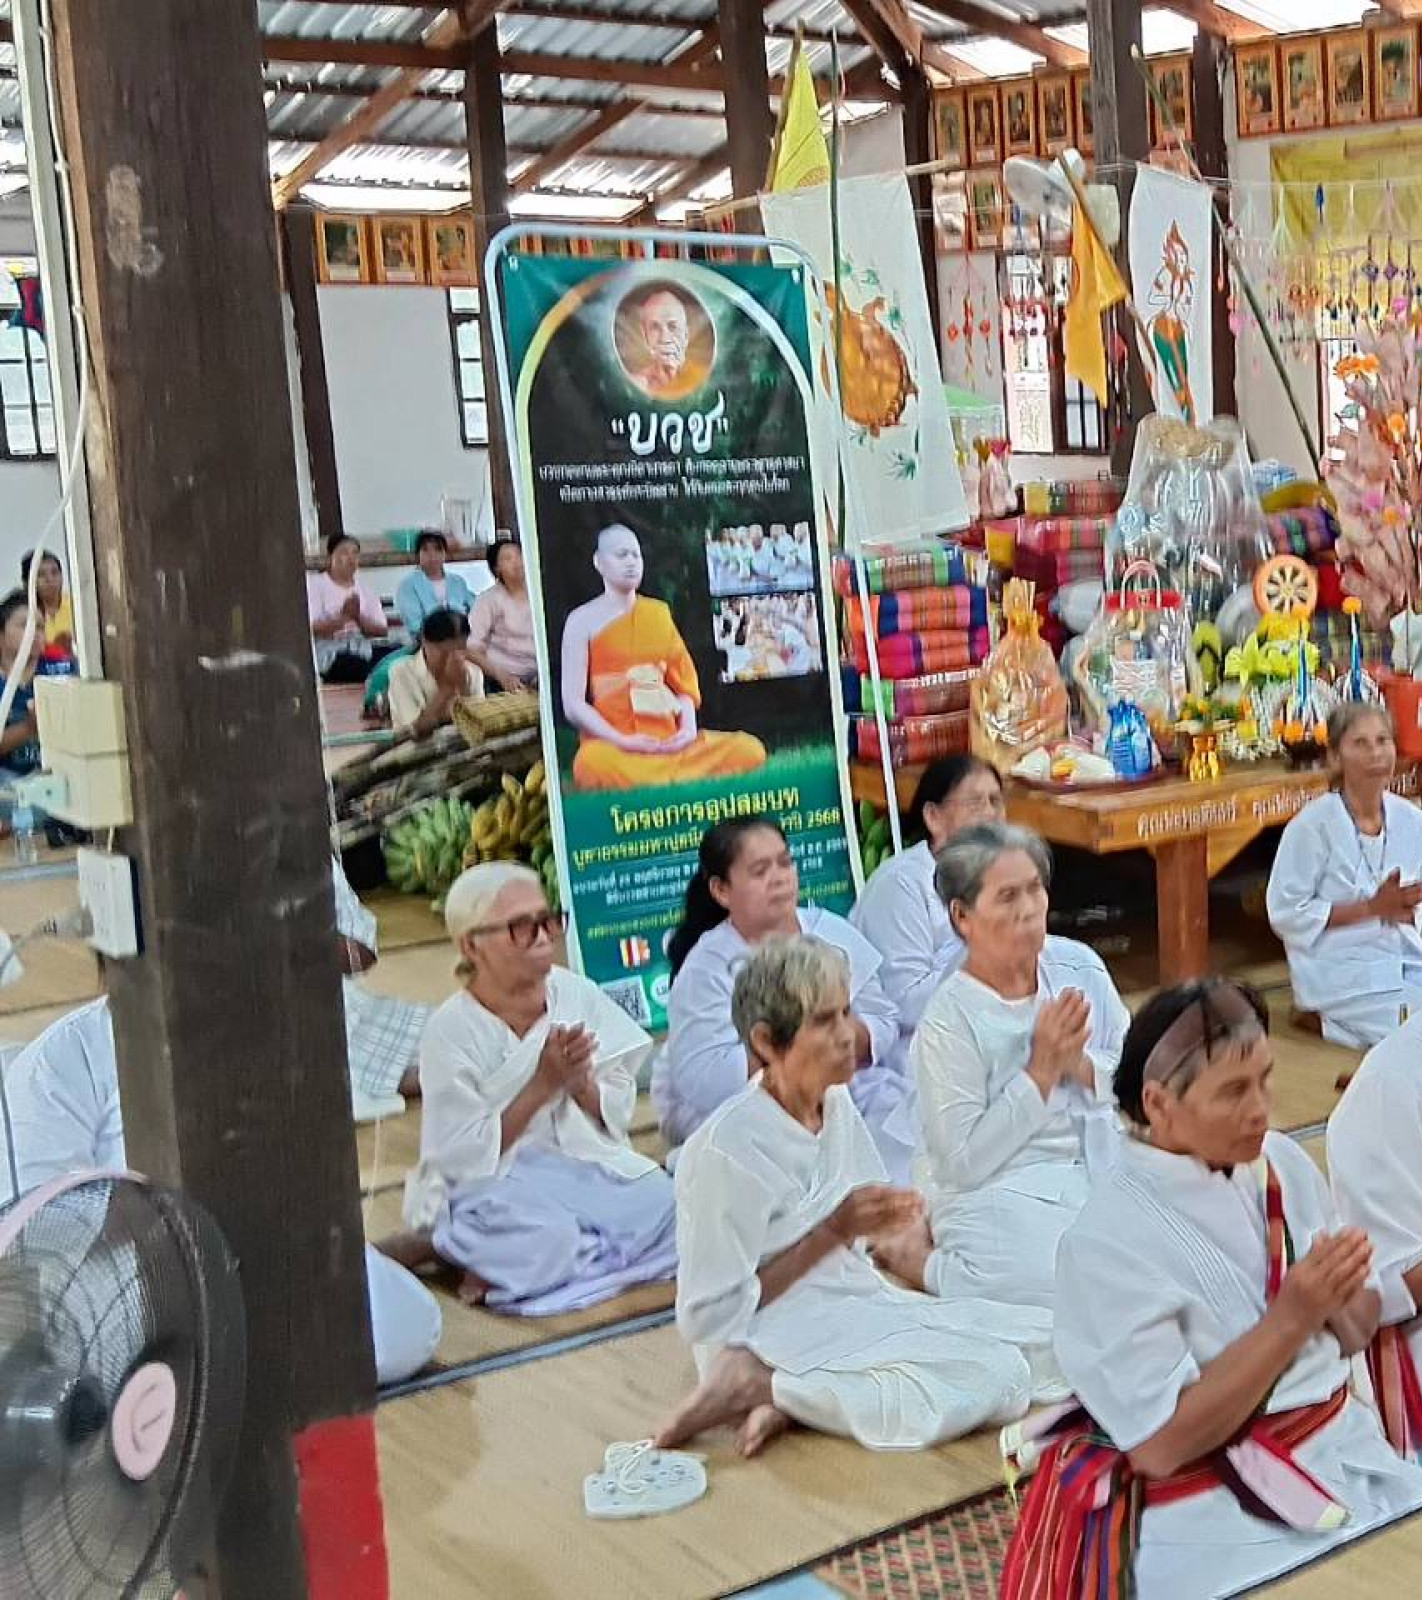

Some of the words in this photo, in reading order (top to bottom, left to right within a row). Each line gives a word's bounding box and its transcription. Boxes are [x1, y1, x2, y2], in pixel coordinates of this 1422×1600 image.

[610, 786, 800, 836] โครงการอุปสมบท
